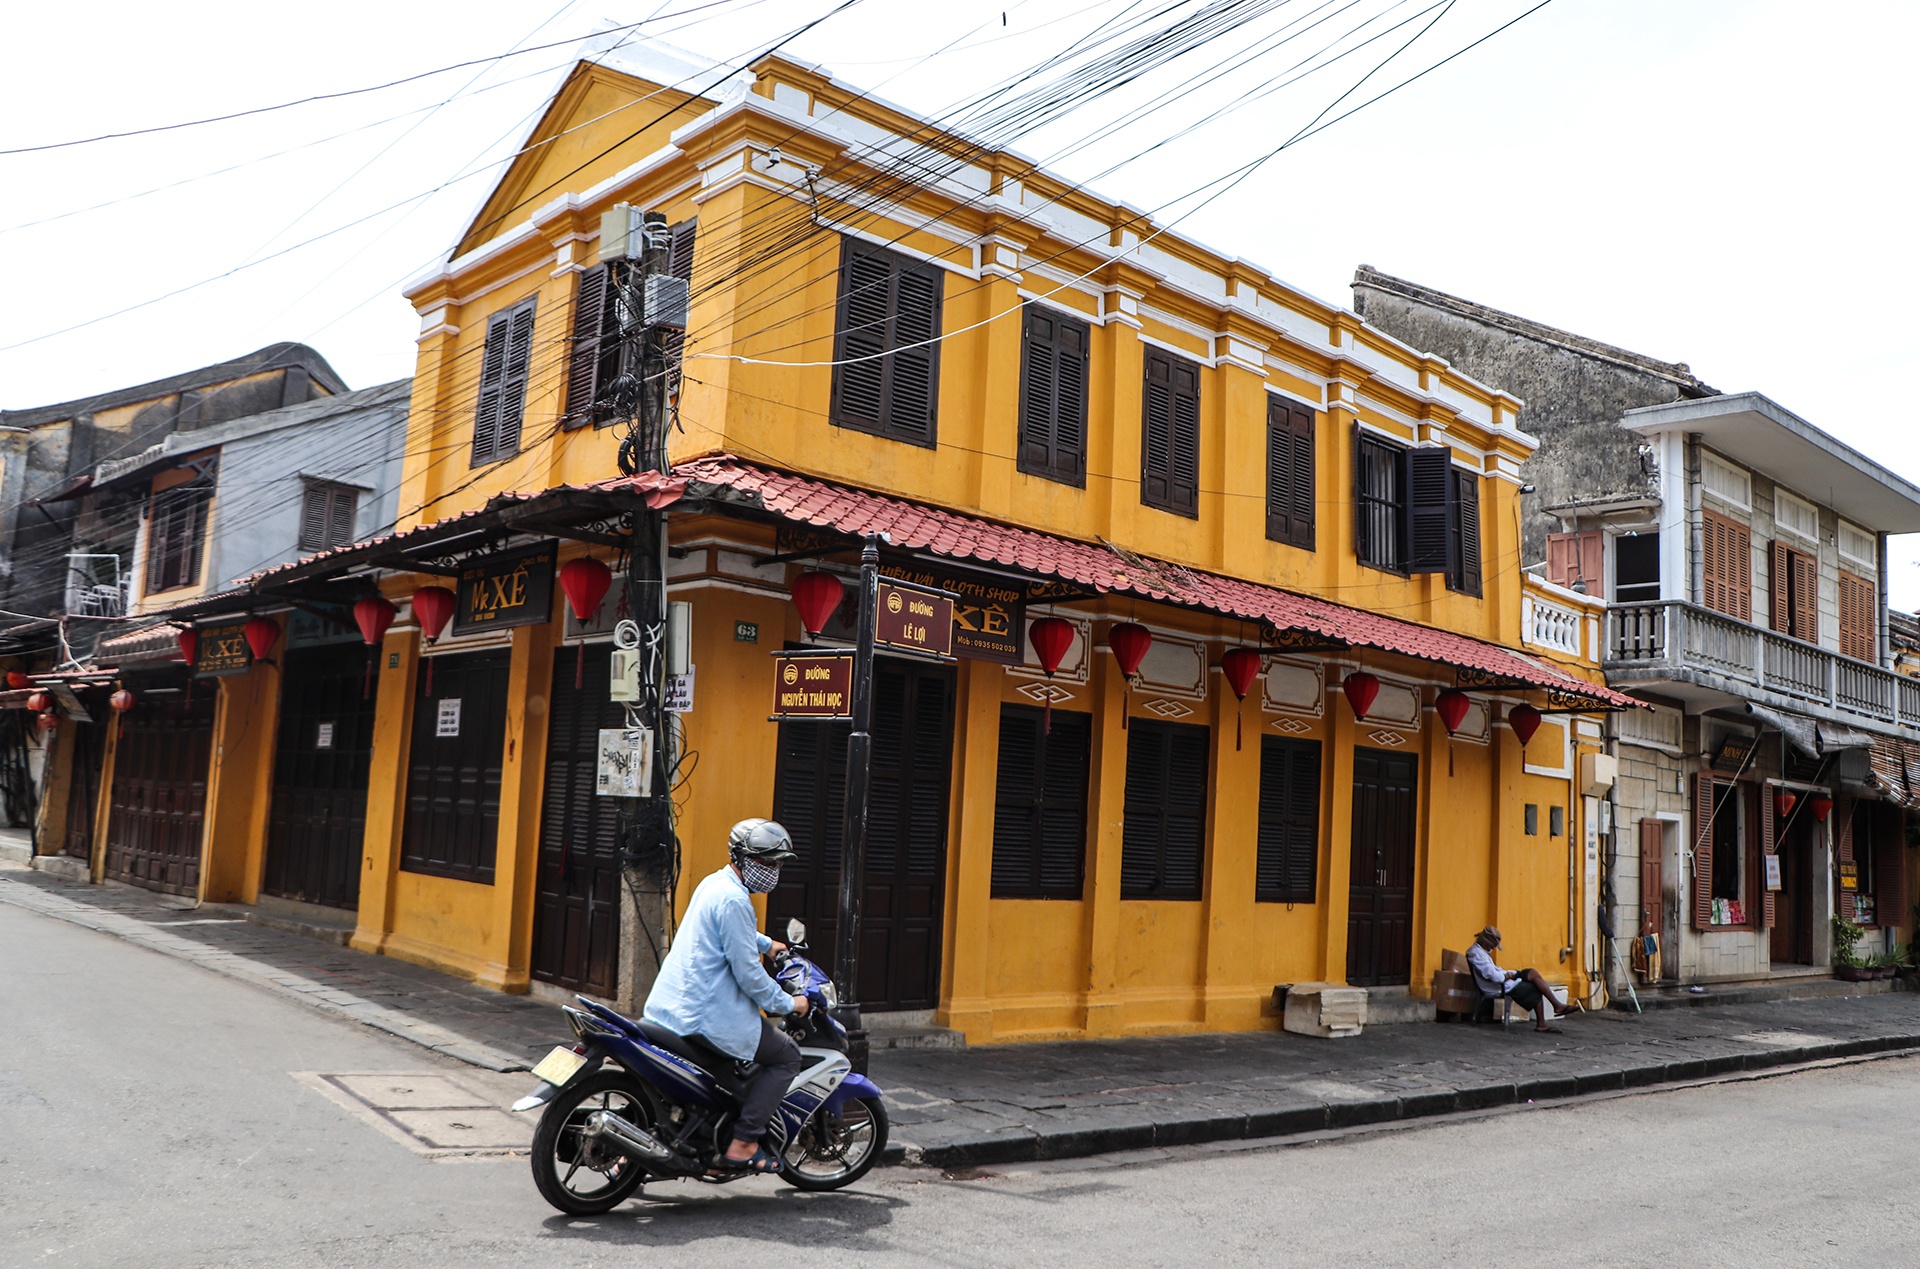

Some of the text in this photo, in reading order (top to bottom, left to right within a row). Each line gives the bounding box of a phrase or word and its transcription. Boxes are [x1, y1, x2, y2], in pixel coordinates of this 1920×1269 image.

[489, 564, 529, 610] XÊ
[942, 579, 985, 597] CLOTH
[986, 586, 1020, 604] SHOP
[909, 600, 934, 617] ĐƯỜNG
[737, 624, 756, 637] 63
[903, 623, 926, 644] LÊ LỢI
[215, 633, 244, 658] XÊ
[974, 640, 991, 649] 0935
[991, 642, 1003, 651] 502
[1004, 644, 1017, 653] 039
[805, 664, 831, 680] ĐƯỜNG
[679, 699, 692, 710] ĐẬP
[781, 687, 843, 709] NGUYỄN THÁI HỌC
